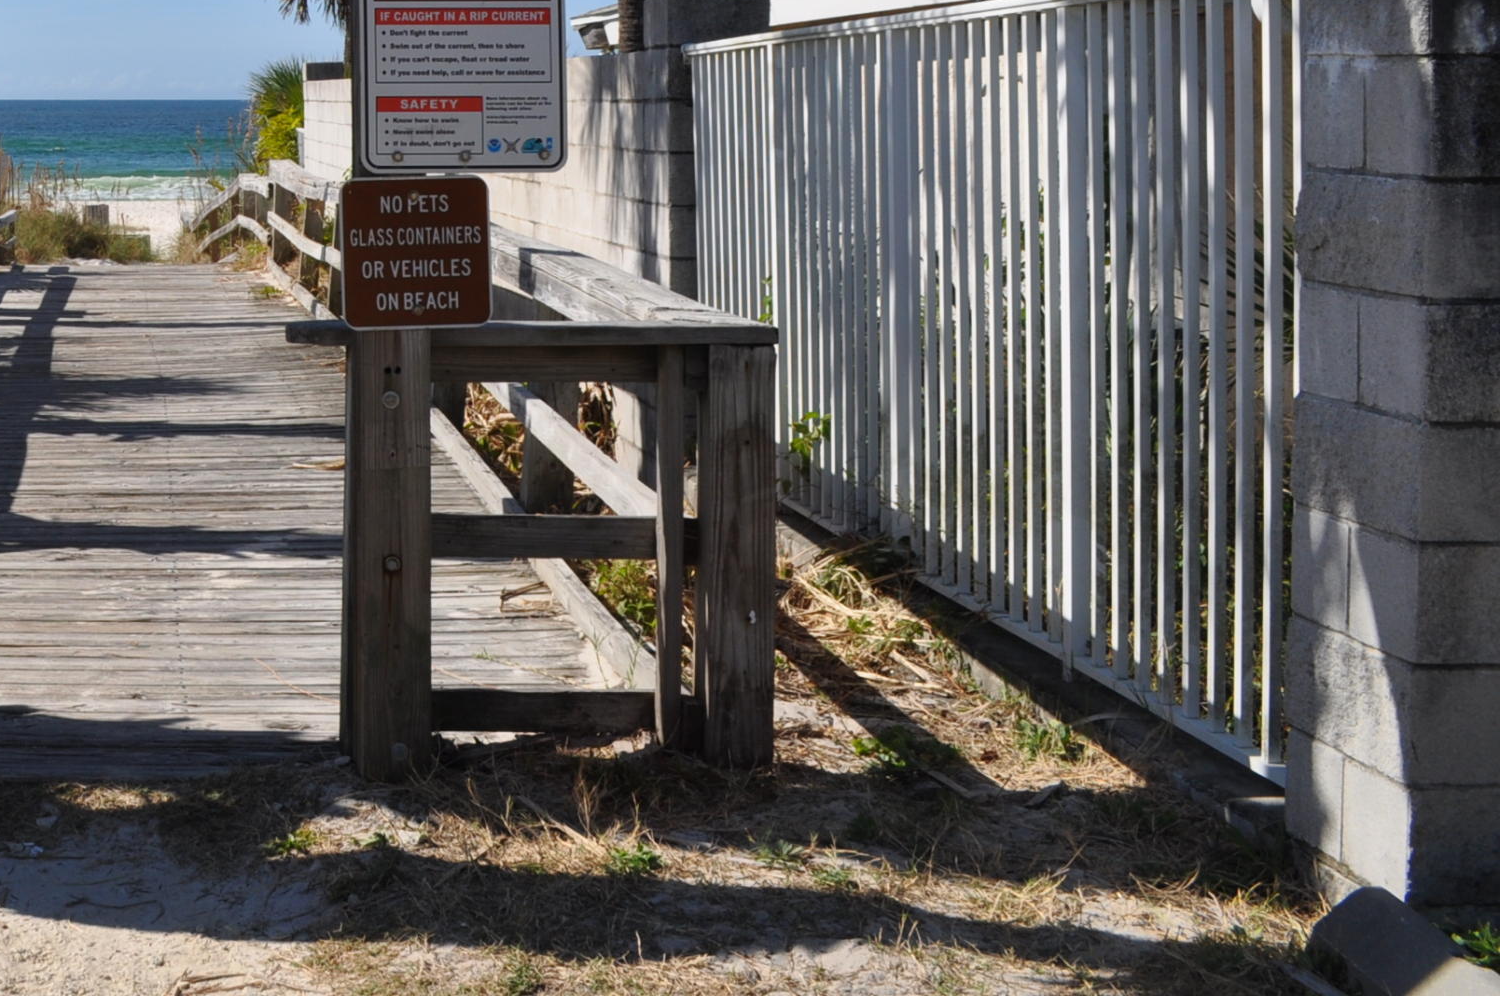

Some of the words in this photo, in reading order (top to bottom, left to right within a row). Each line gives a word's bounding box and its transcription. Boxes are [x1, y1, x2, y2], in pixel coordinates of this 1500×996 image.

[380, 11, 389, 21] IF
[394, 11, 440, 21] CAUGHT
[443, 11, 456, 21] IN
[459, 11, 467, 21] A
[469, 11, 488, 21] RIP
[491, 11, 545, 21] CURRENT
[400, 99, 459, 109] SAFETY
[380, 195, 403, 214] NO
[407, 194, 449, 213] PETS
[350, 228, 394, 247] GLASS
[397, 226, 481, 246] CONTAINERS
[361, 261, 384, 279] OR
[389, 258, 472, 279] VEHICLES
[376, 293, 399, 311] ON
[403, 291, 459, 310] BEACH
